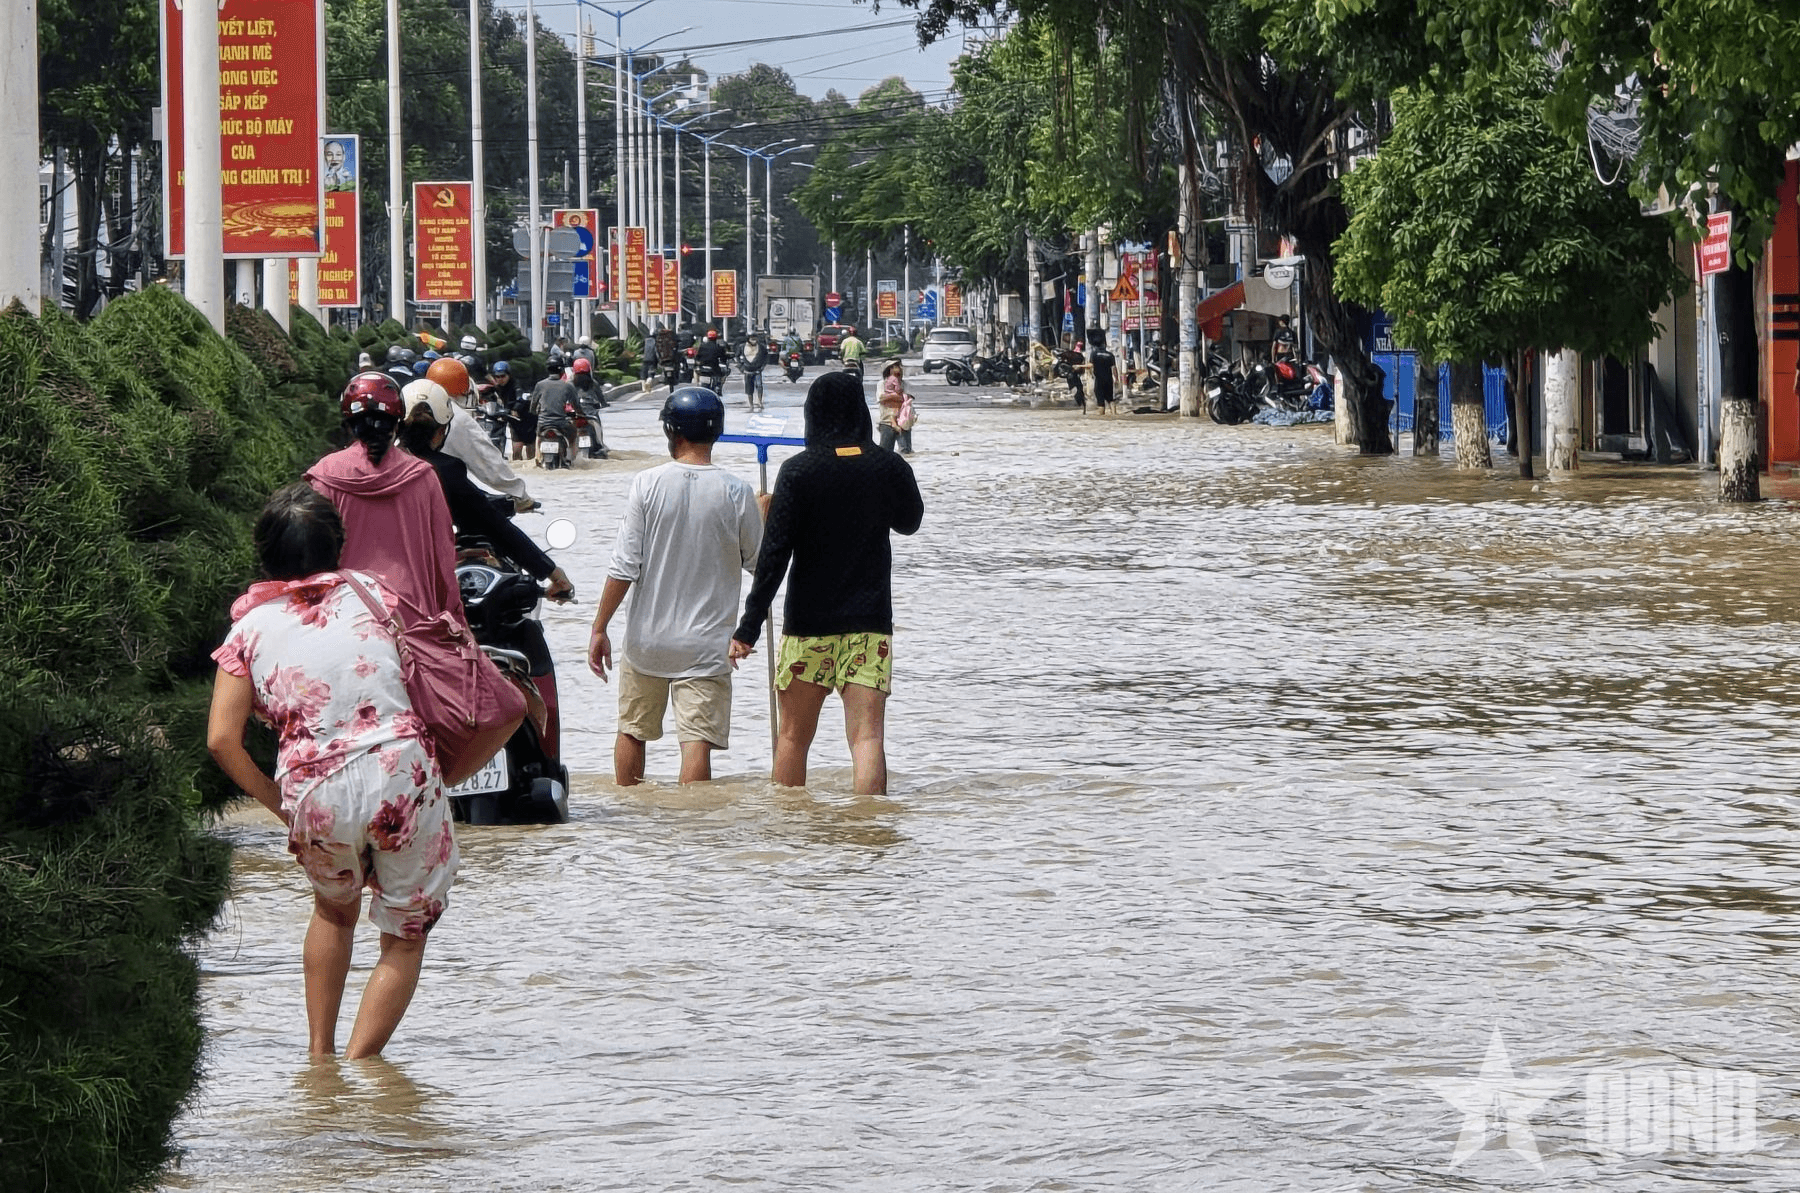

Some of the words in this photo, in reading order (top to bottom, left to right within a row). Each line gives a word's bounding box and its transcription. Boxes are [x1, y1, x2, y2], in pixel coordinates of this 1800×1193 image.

[218, 15, 244, 35] YẾT
[247, 17, 277, 38] LIỆT,
[220, 70, 247, 85] ONG
[251, 66, 278, 88] VIỆC
[244, 89, 268, 110] XẾP
[246, 116, 262, 138] BỘ
[265, 116, 293, 135] MÁY
[231, 140, 256, 160] CỦA
[241, 166, 279, 185] CHÍNH
